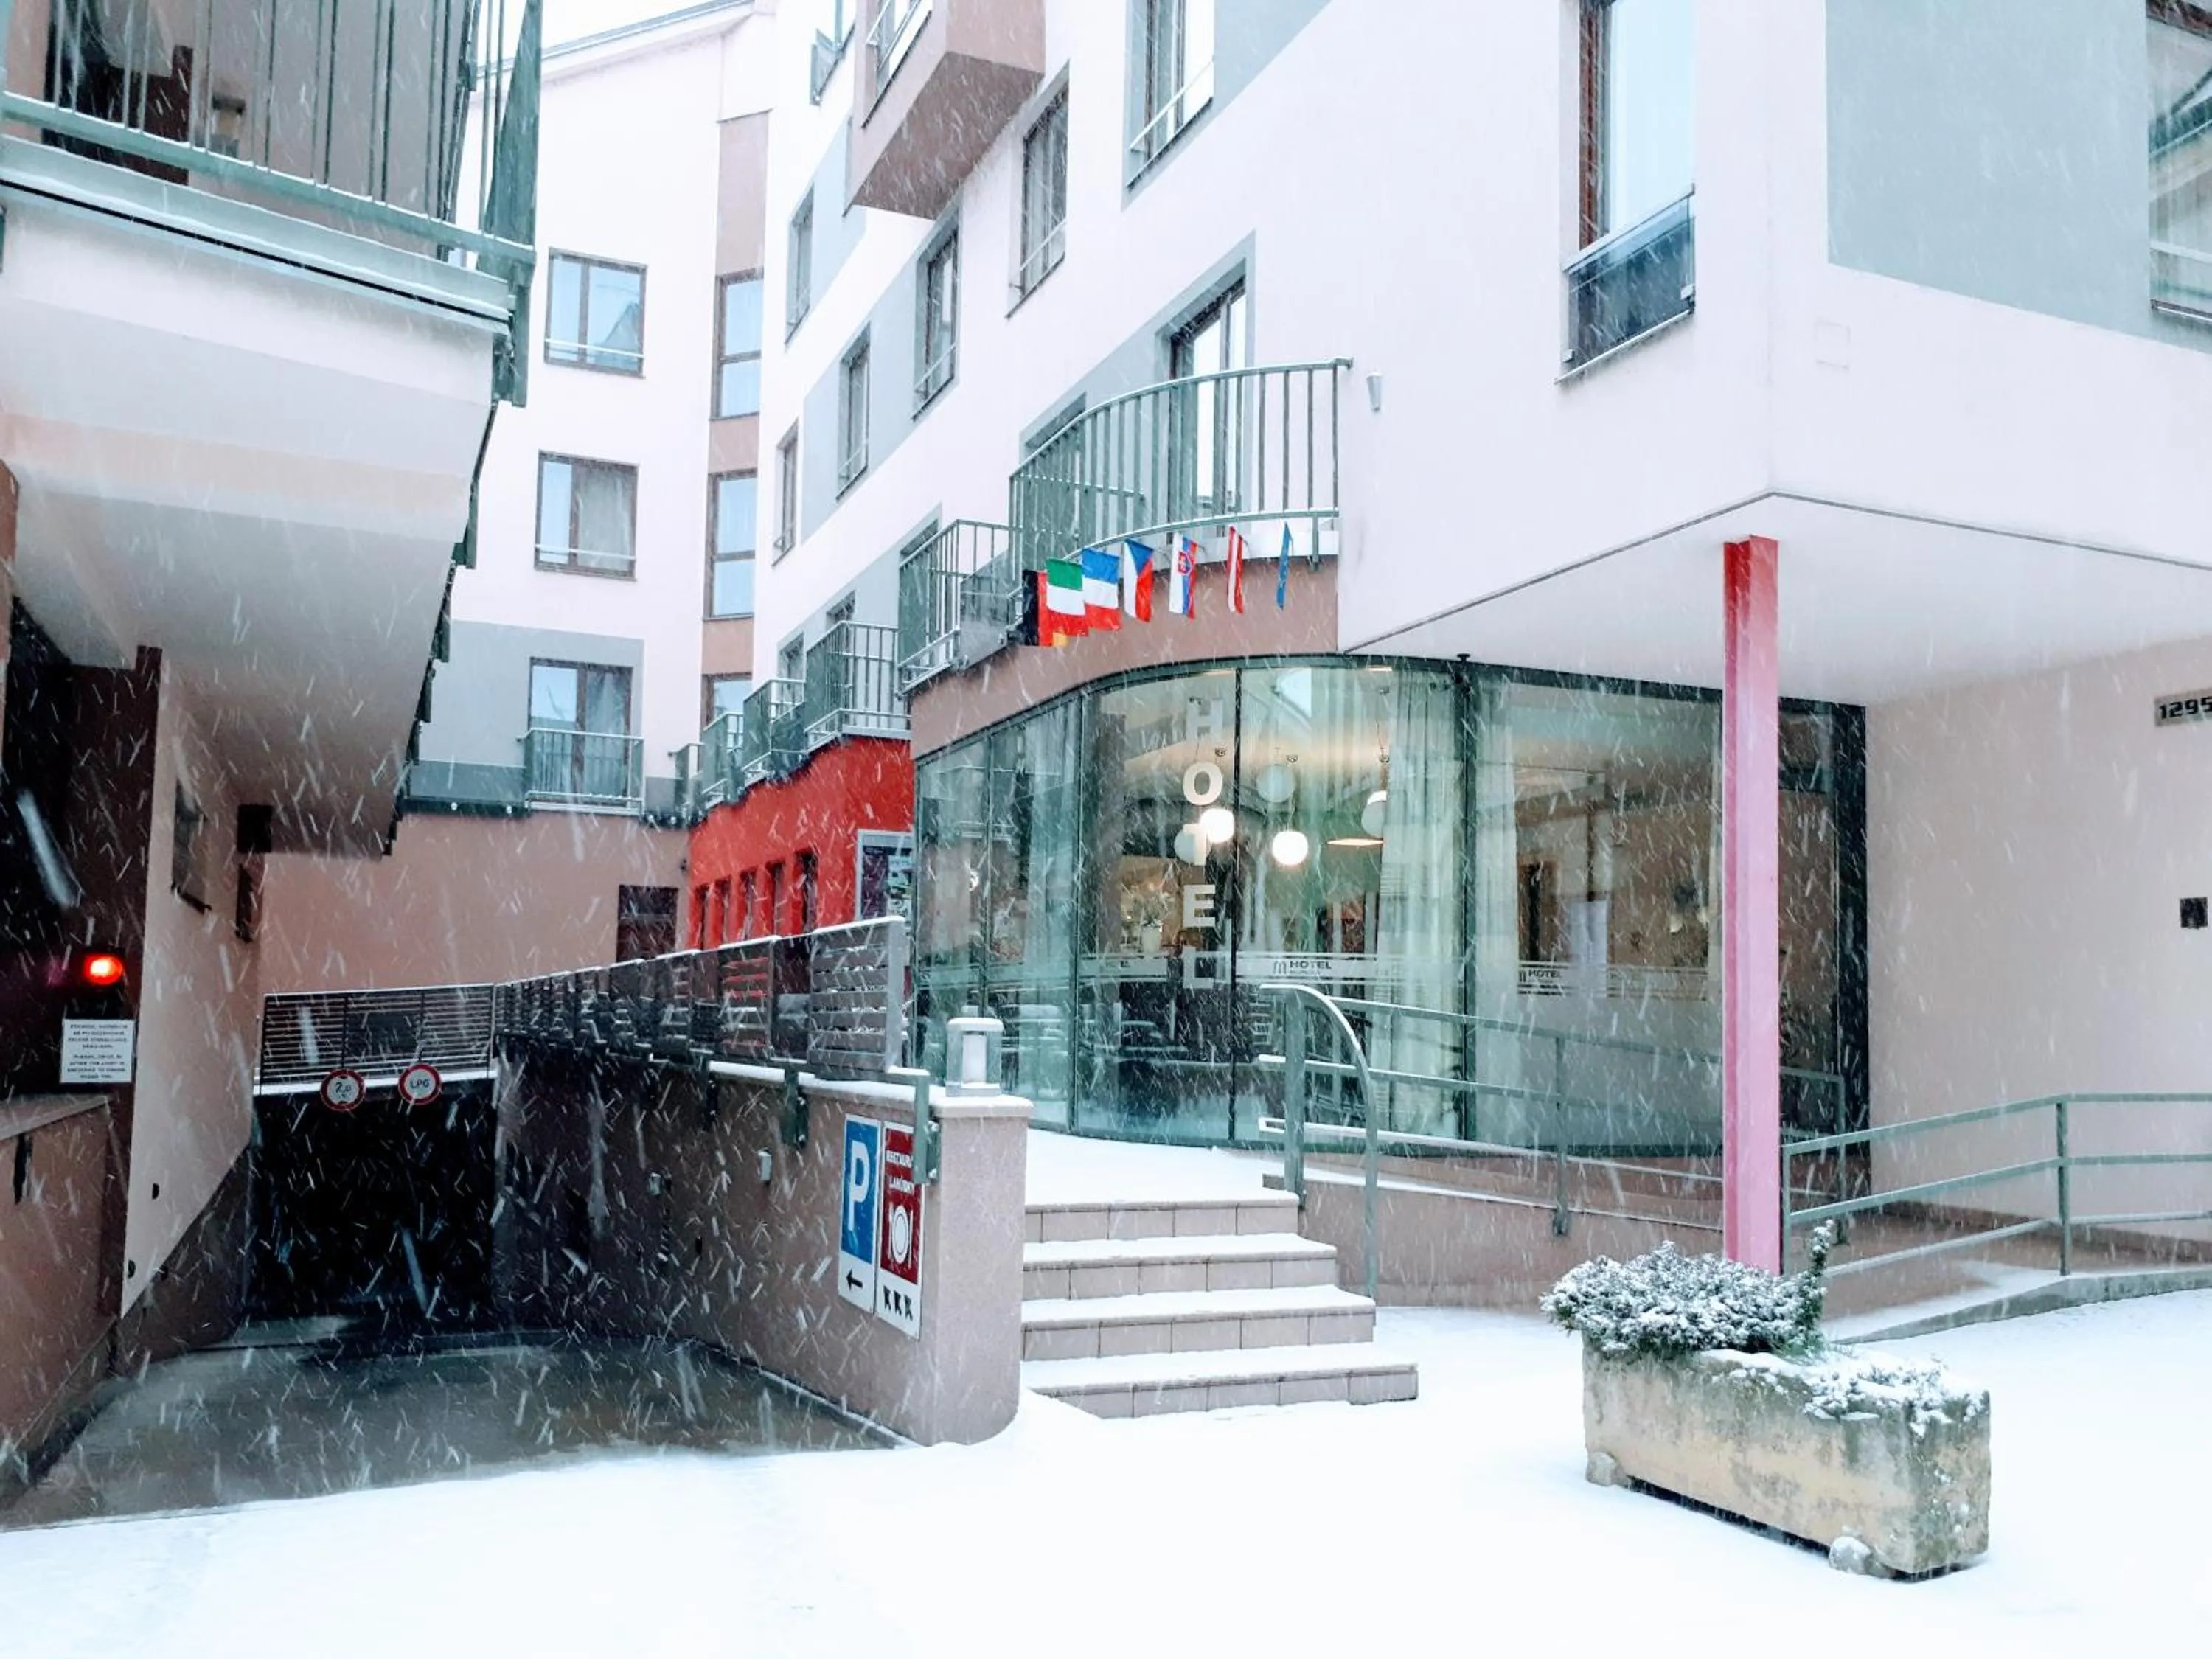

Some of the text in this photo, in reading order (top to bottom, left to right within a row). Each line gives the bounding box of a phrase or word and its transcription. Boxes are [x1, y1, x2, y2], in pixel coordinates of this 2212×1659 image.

[2158, 695, 2212, 720] 1295
[1182, 697, 1224, 990] HOTEL
[1290, 961, 1332, 970] HOTEL
[409, 1079, 431, 1089] LPG
[848, 1139, 870, 1232] P
